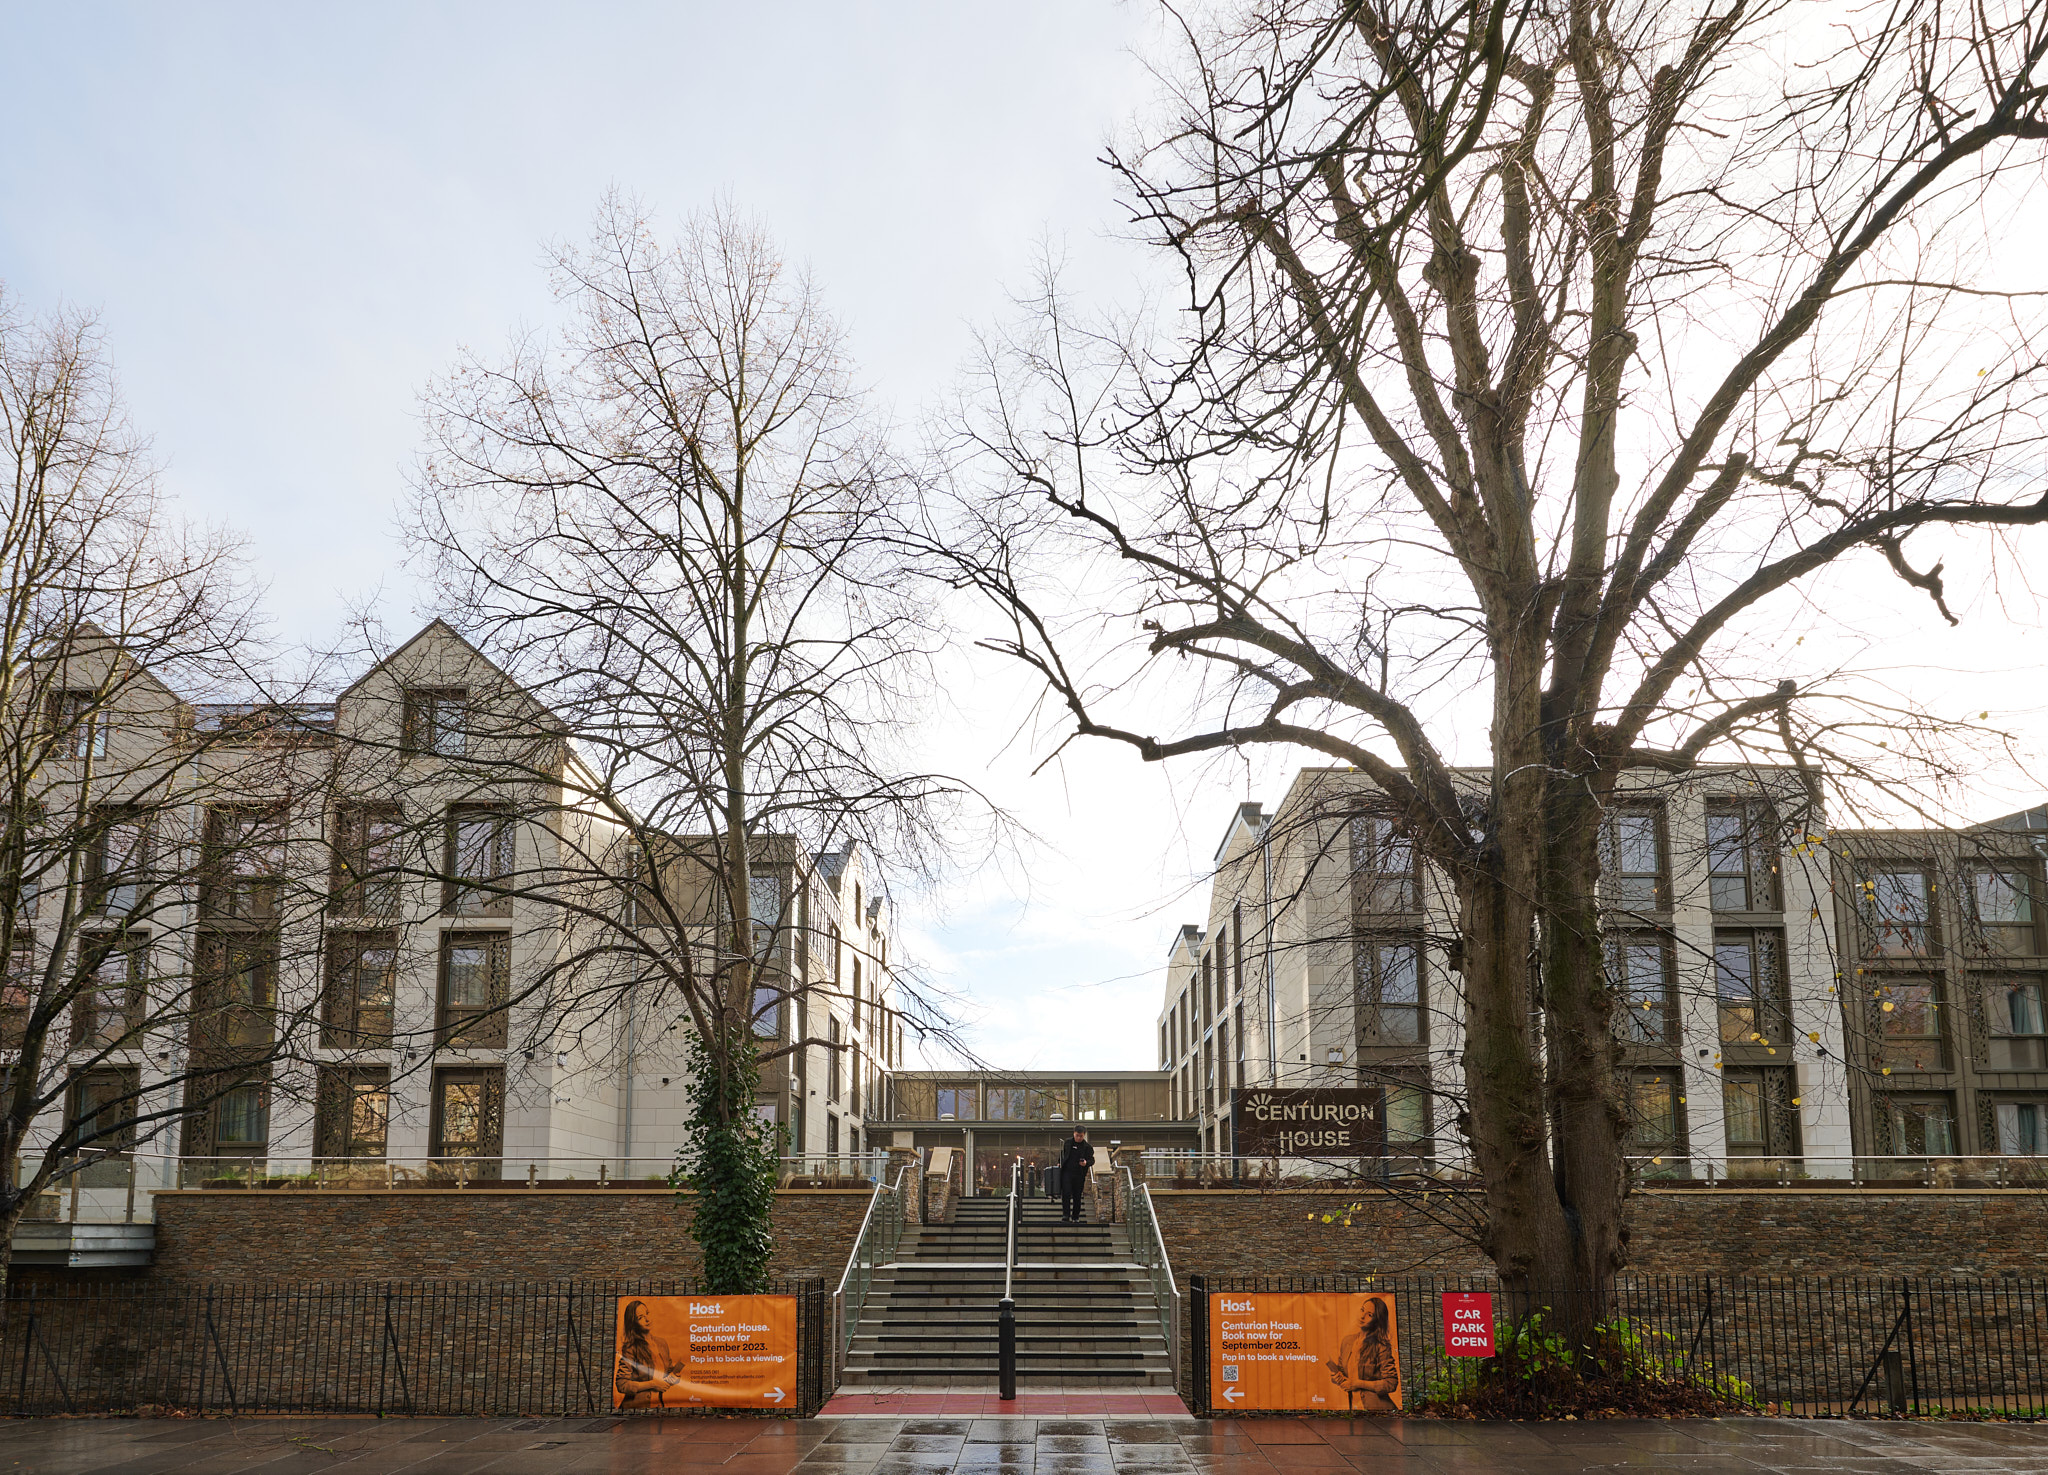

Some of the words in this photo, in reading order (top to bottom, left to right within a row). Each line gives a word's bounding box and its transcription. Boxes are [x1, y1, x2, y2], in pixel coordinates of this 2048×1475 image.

[1255, 1105, 1373, 1127] CENTURION
[1280, 1130, 1350, 1155] HOUSE
[689, 1303, 724, 1314] Host.
[1220, 1299, 1255, 1311] Host.
[1455, 1309, 1481, 1319] CAR
[689, 1324, 736, 1333] Centurion
[738, 1323, 770, 1332] House.
[1222, 1321, 1267, 1330] Centurion
[1270, 1321, 1302, 1330] House.
[1452, 1323, 1485, 1333] PARK
[690, 1334, 713, 1342] Book
[737, 1333, 750, 1342] for
[1222, 1331, 1244, 1340] Book
[1247, 1332, 1267, 1340] now
[1269, 1331, 1283, 1340] for
[1222, 1341, 1273, 1351] September
[1275, 1341, 1300, 1350] 2023.
[1451, 1337, 1487, 1346] OPEN
[690, 1344, 740, 1353] September
[743, 1343, 768, 1351] 2023.
[691, 1355, 705, 1364] Pop
[725, 1354, 744, 1362] book
[753, 1354, 785, 1363] viewing.
[1222, 1353, 1236, 1363] Pop
[1239, 1353, 1245, 1361] in
[1257, 1353, 1277, 1361] book
[1285, 1353, 1318, 1363] viewing.
